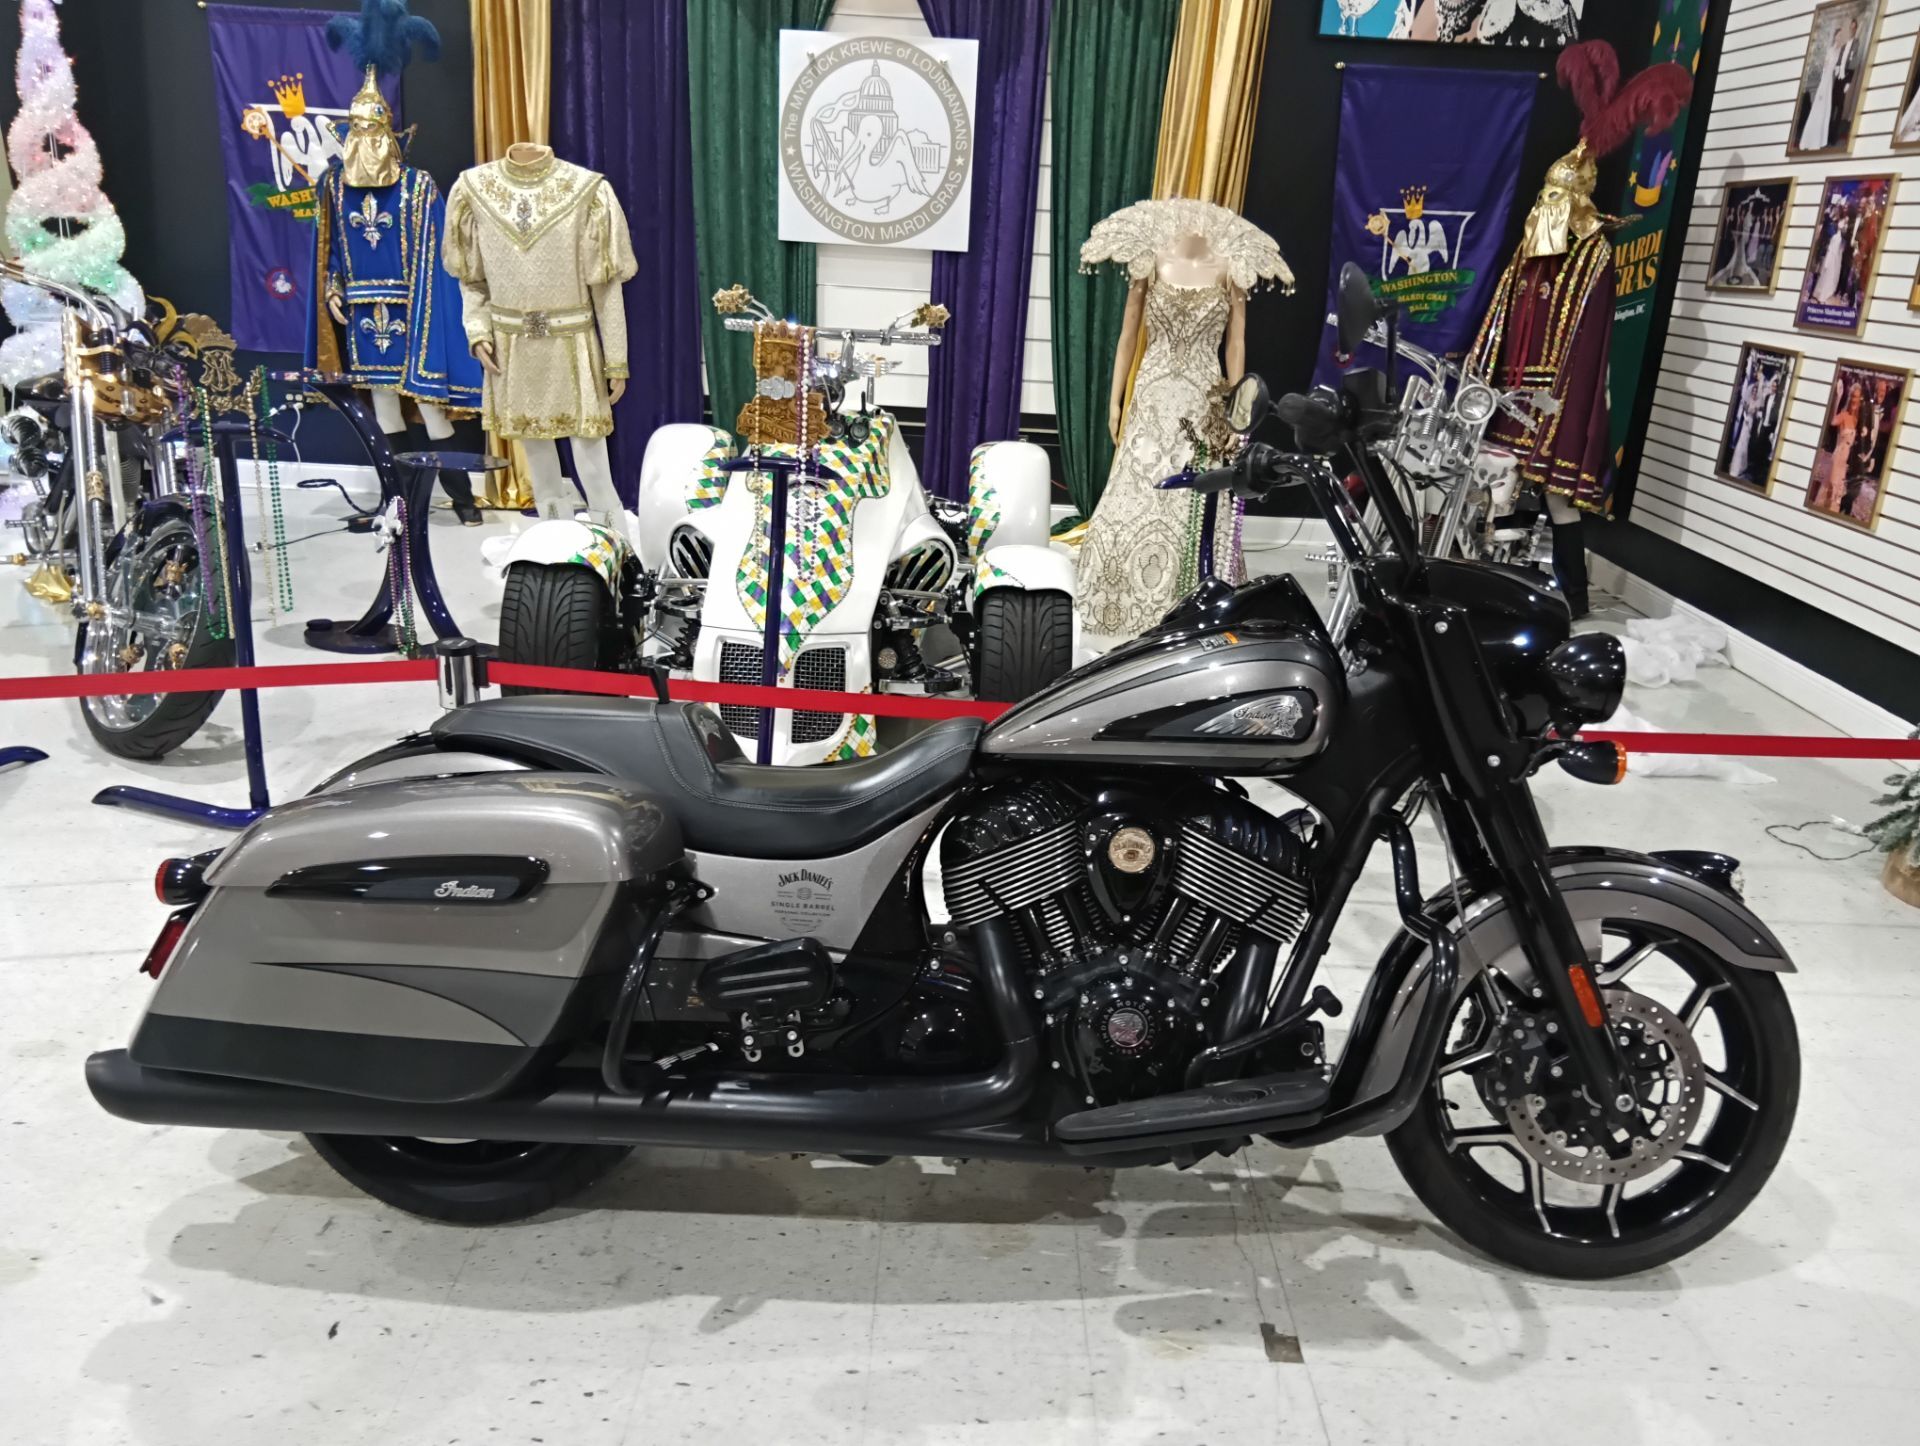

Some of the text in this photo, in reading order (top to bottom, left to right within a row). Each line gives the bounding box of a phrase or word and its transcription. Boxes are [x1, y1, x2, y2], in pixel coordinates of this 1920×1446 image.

[784, 40, 967, 151] The MYSTICK KREWE of LOUISIANIANS
[788, 160, 962, 240] WASHINGTON MARDI GRAS
[1615, 229, 1664, 267] MARDI
[1381, 272, 1458, 293] WASHINGTON
[1398, 293, 1448, 302] MARDI GRAS
[1408, 303, 1430, 312] BALL
[1233, 708, 1275, 720] Indian
[433, 880, 496, 898] Indian
[778, 868, 834, 891] JACK DANIEL'S
[771, 901, 836, 911] SINGLE BARREL
